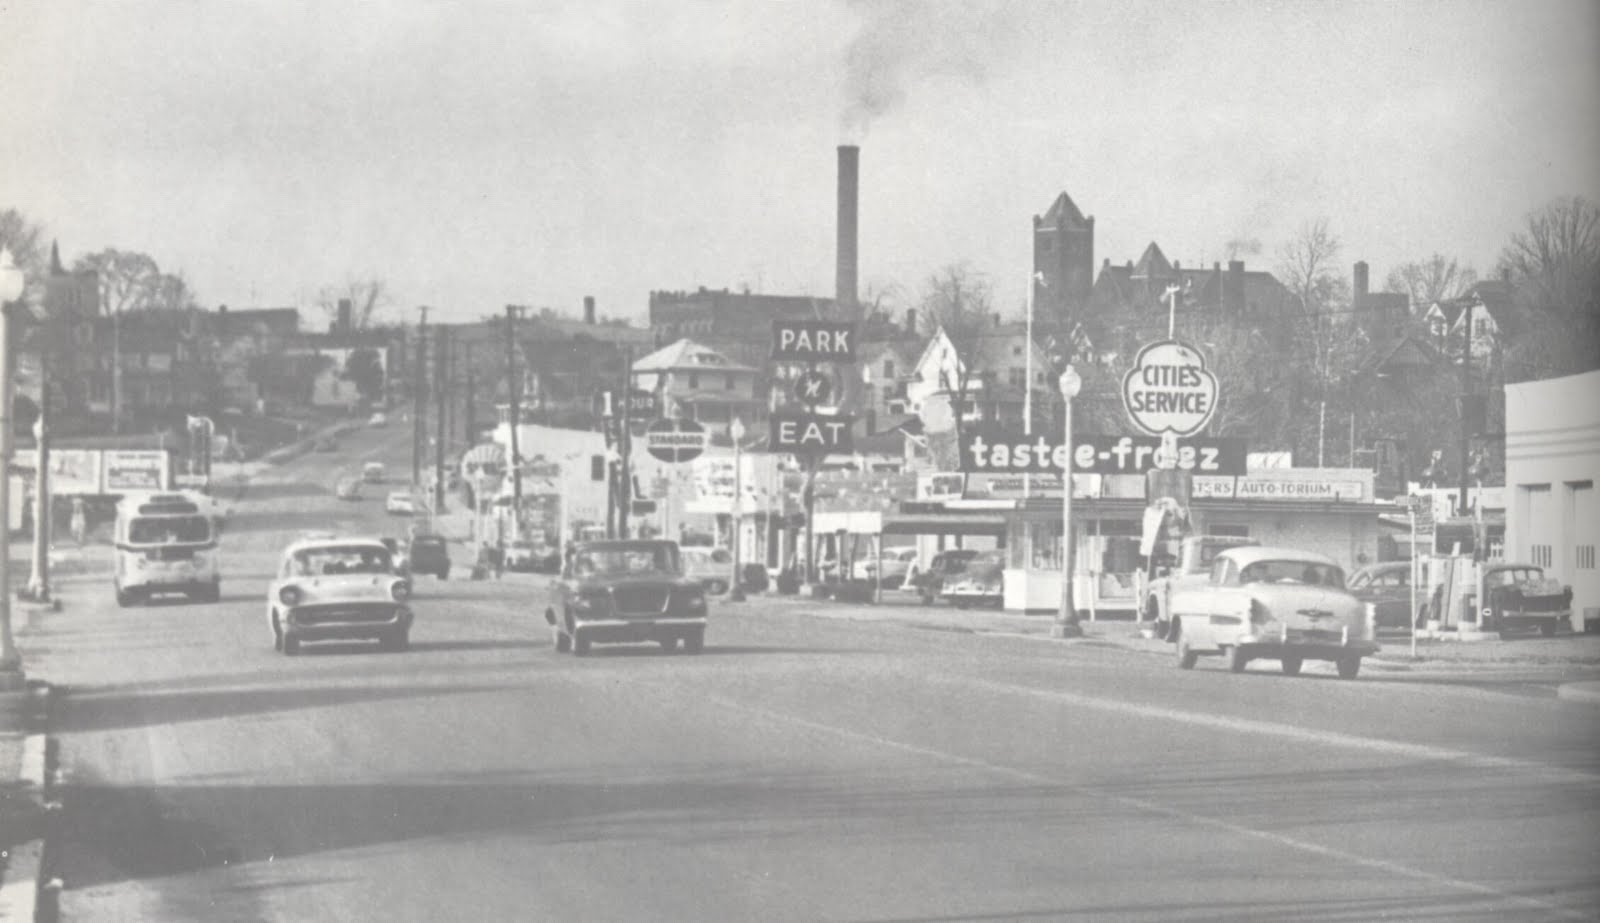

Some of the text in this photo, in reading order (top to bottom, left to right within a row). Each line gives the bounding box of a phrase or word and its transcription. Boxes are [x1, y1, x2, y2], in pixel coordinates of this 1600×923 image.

[780, 328, 849, 353] PARK
[1143, 364, 1203, 387] CITIES
[1131, 391, 1206, 414] SERVICE
[649, 435, 704, 446] STANDARD
[779, 421, 846, 445] EAT
[1240, 482, 1332, 495] AUTO-TORIUM
